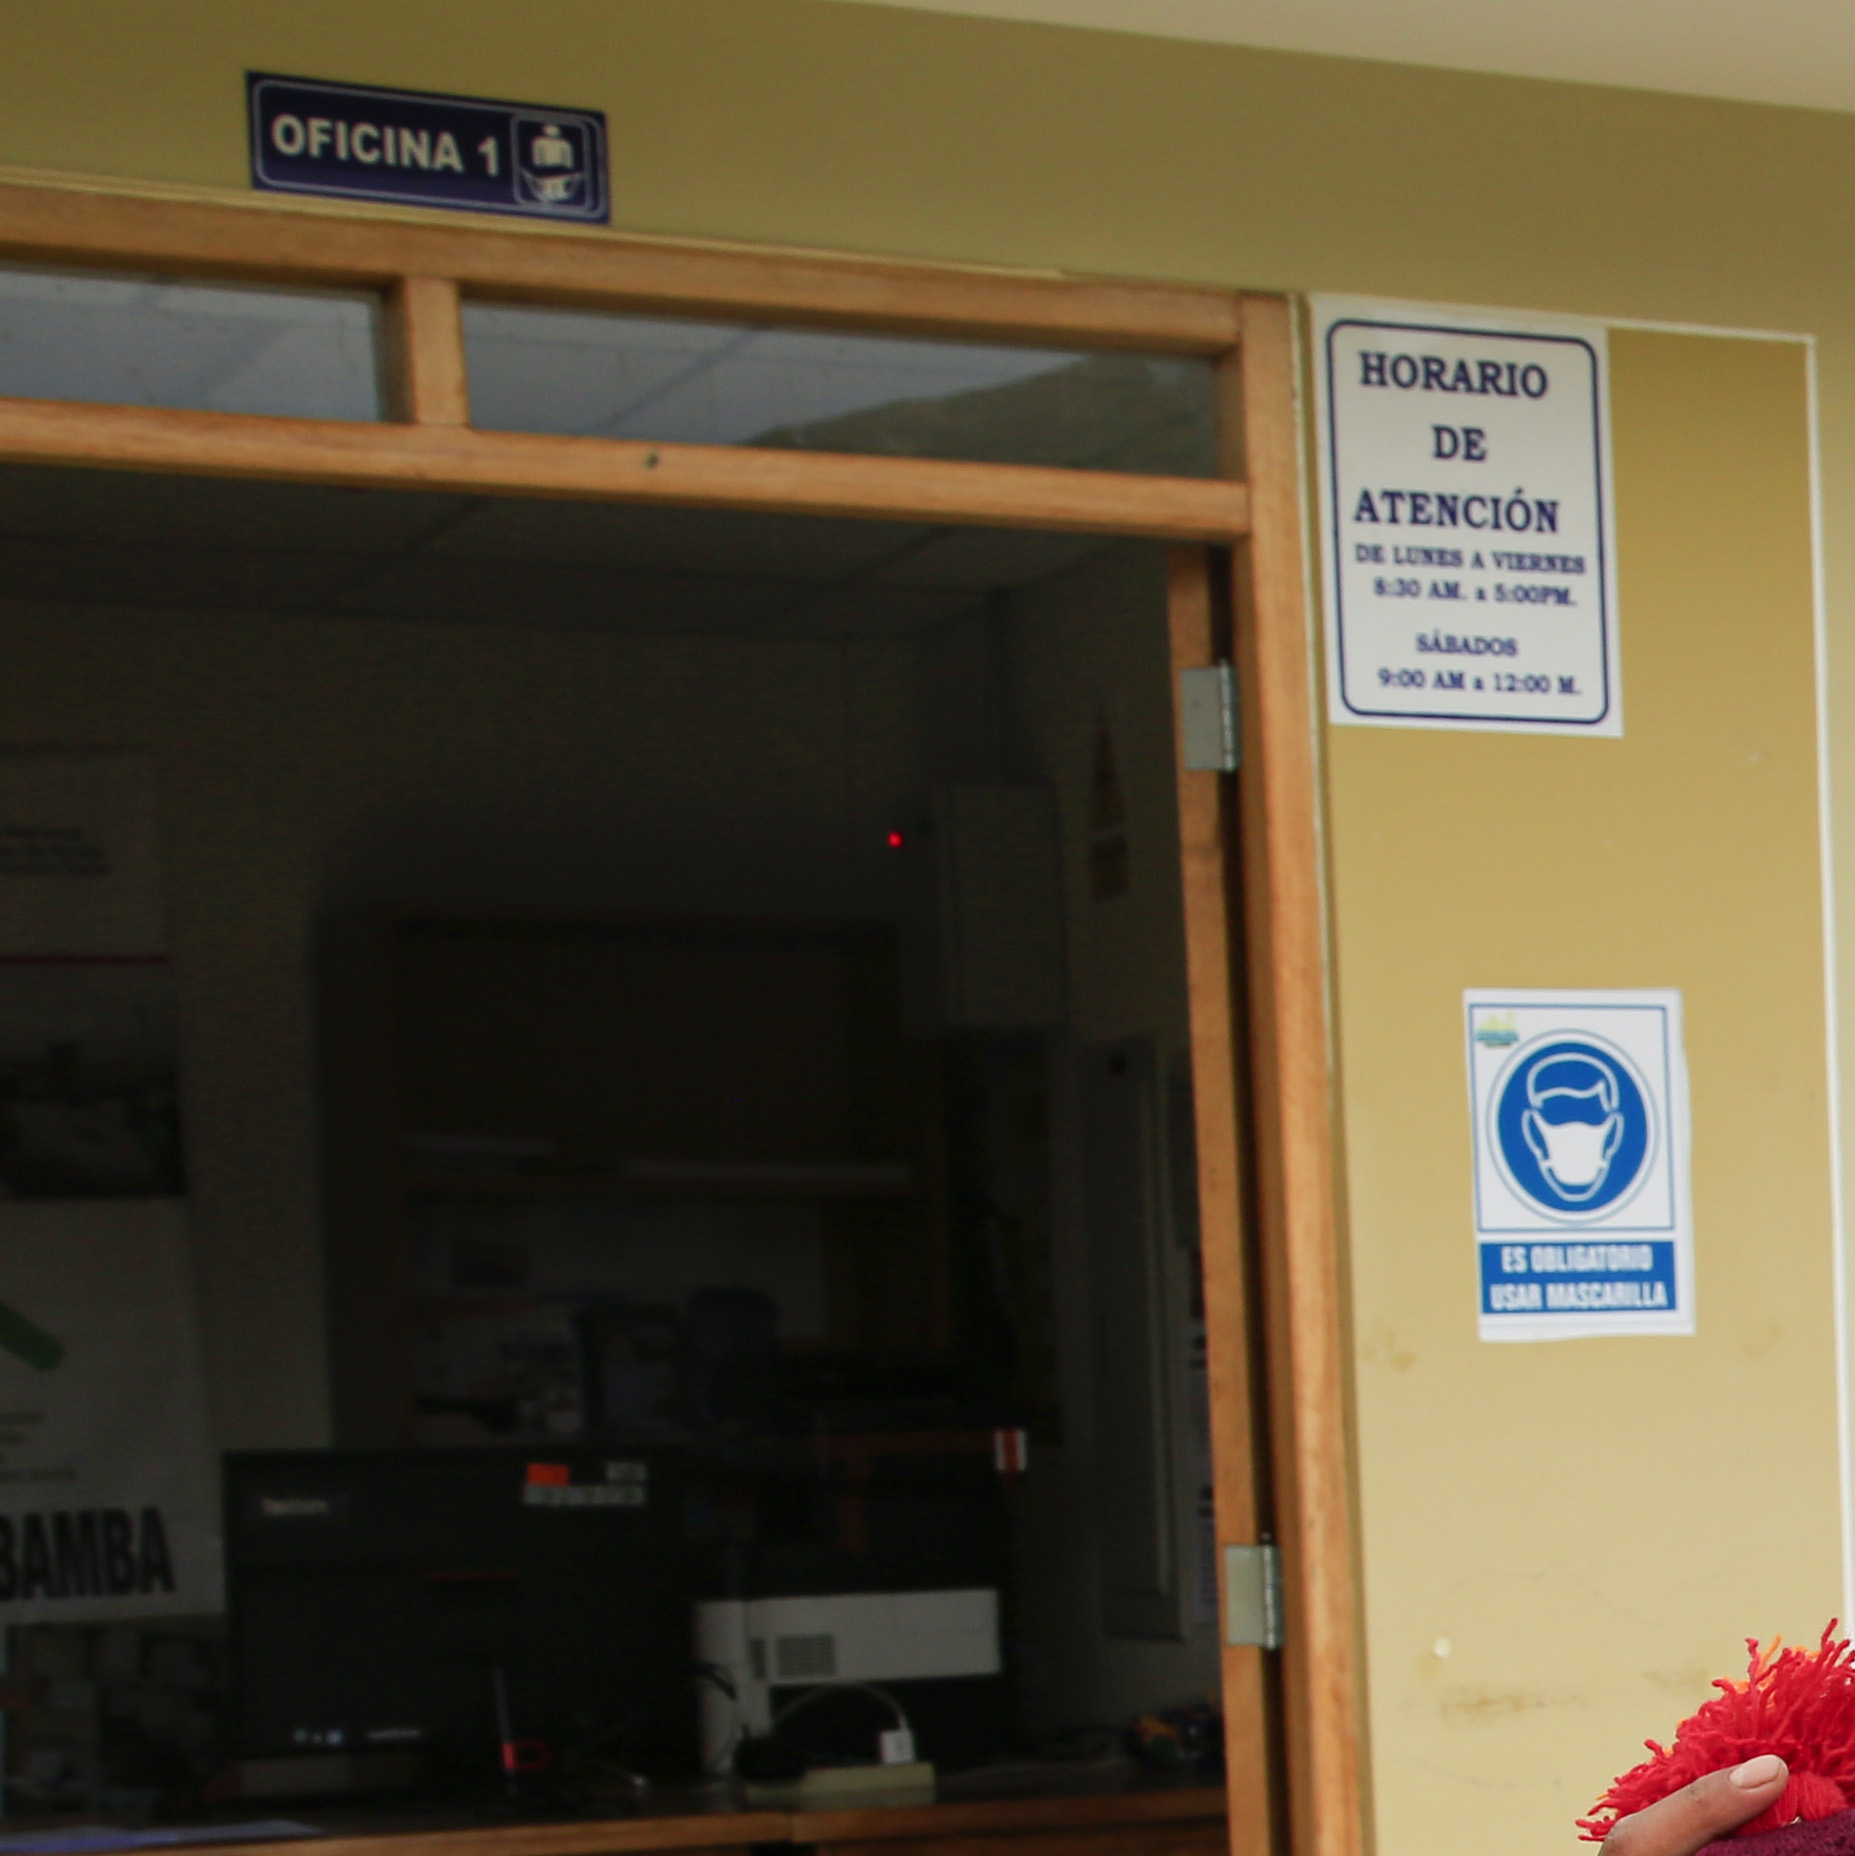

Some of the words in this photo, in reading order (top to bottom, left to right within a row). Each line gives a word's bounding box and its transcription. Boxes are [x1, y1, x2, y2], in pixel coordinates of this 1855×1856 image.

[271, 113, 464, 173] OFICINA
[478, 135, 499, 177] 1
[1358, 350, 1548, 398] HORARIO
[1432, 425, 1487, 462] DE
[1354, 488, 1560, 534] ATENCIÓN
[1355, 544, 1384, 564] DE
[1393, 546, 1463, 568] LUNES
[1471, 551, 1485, 569] A
[1492, 552, 1586, 574] VIERNES
[1416, 628, 1519, 657] SÁBADOS
[1378, 667, 1425, 688] 9:00
[1494, 672, 1550, 693] 12:00
[1501, 1245, 1527, 1273] ES
[1530, 1244, 1653, 1273] OBLIGATORIO
[1489, 1282, 1542, 1311] USAR
[1546, 1280, 1668, 1309] MASCARILLA
